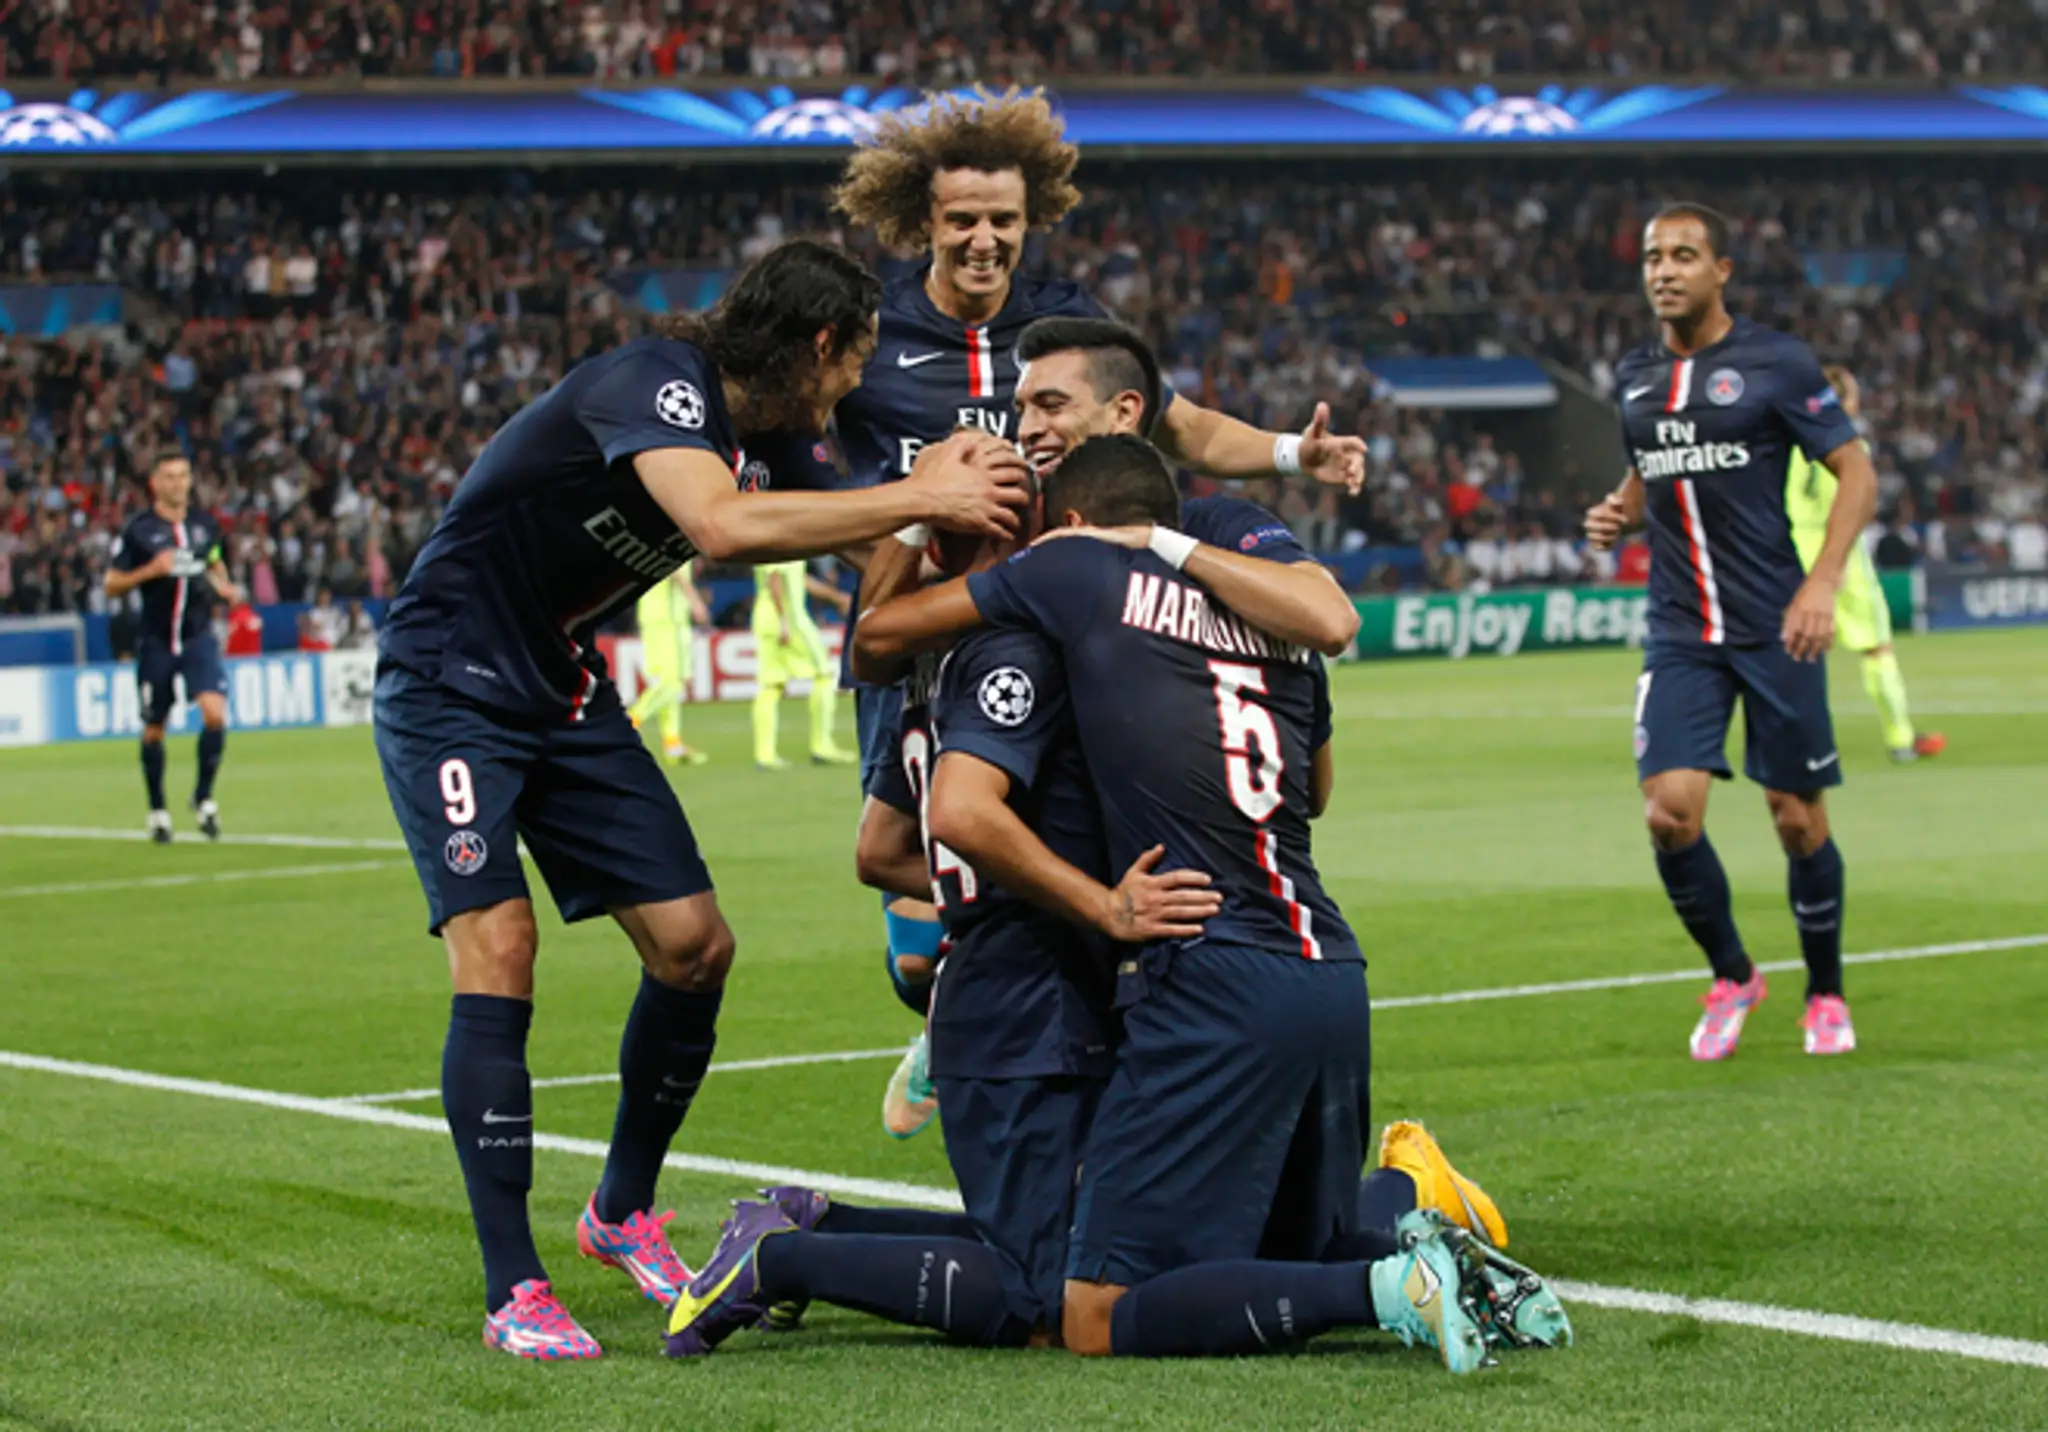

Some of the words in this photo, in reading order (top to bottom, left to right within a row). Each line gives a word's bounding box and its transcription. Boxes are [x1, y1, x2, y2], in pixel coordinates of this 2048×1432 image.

[958, 407, 1008, 440] Fly
[1655, 419, 1697, 445] Fly
[1392, 590, 1534, 660] Enjoy
[75, 660, 315, 735] GAOM
[1208, 658, 1285, 824] 5
[438, 757, 477, 825] 9
